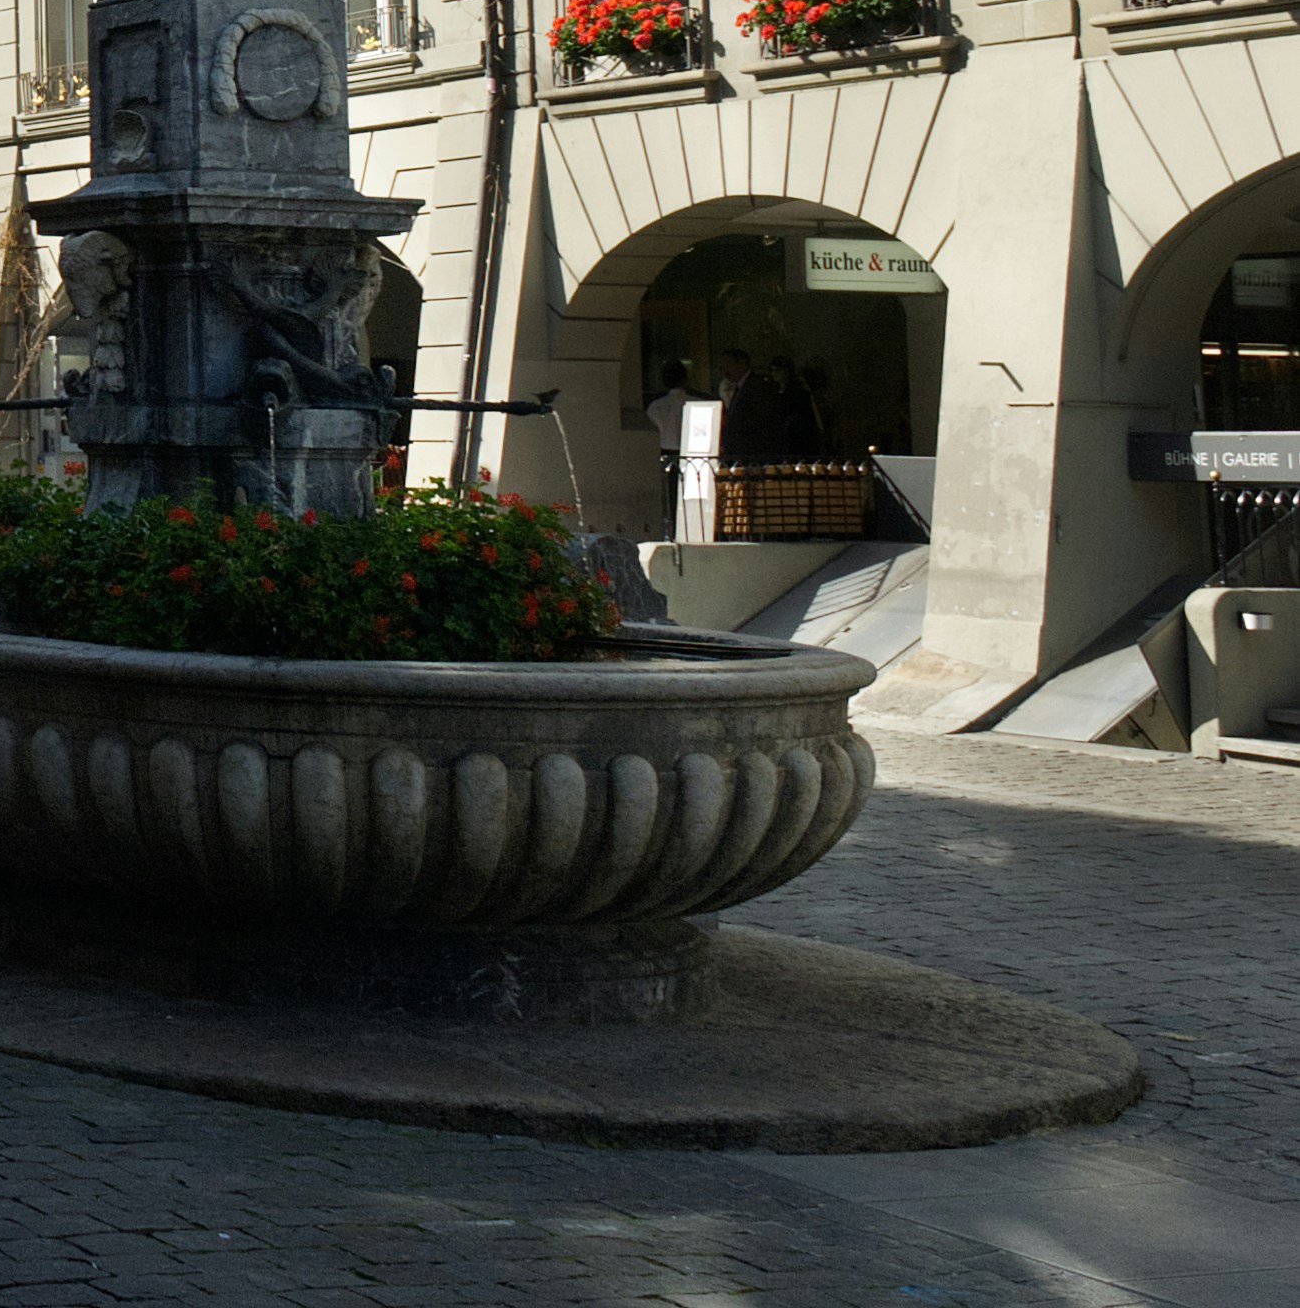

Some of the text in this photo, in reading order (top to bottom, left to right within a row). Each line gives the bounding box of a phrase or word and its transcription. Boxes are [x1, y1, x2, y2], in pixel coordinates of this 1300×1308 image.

[810, 251, 864, 271] küche
[868, 252, 884, 272] &
[1165, 450, 1209, 466] BÜHNE
[1222, 451, 1279, 467] GALERIE
